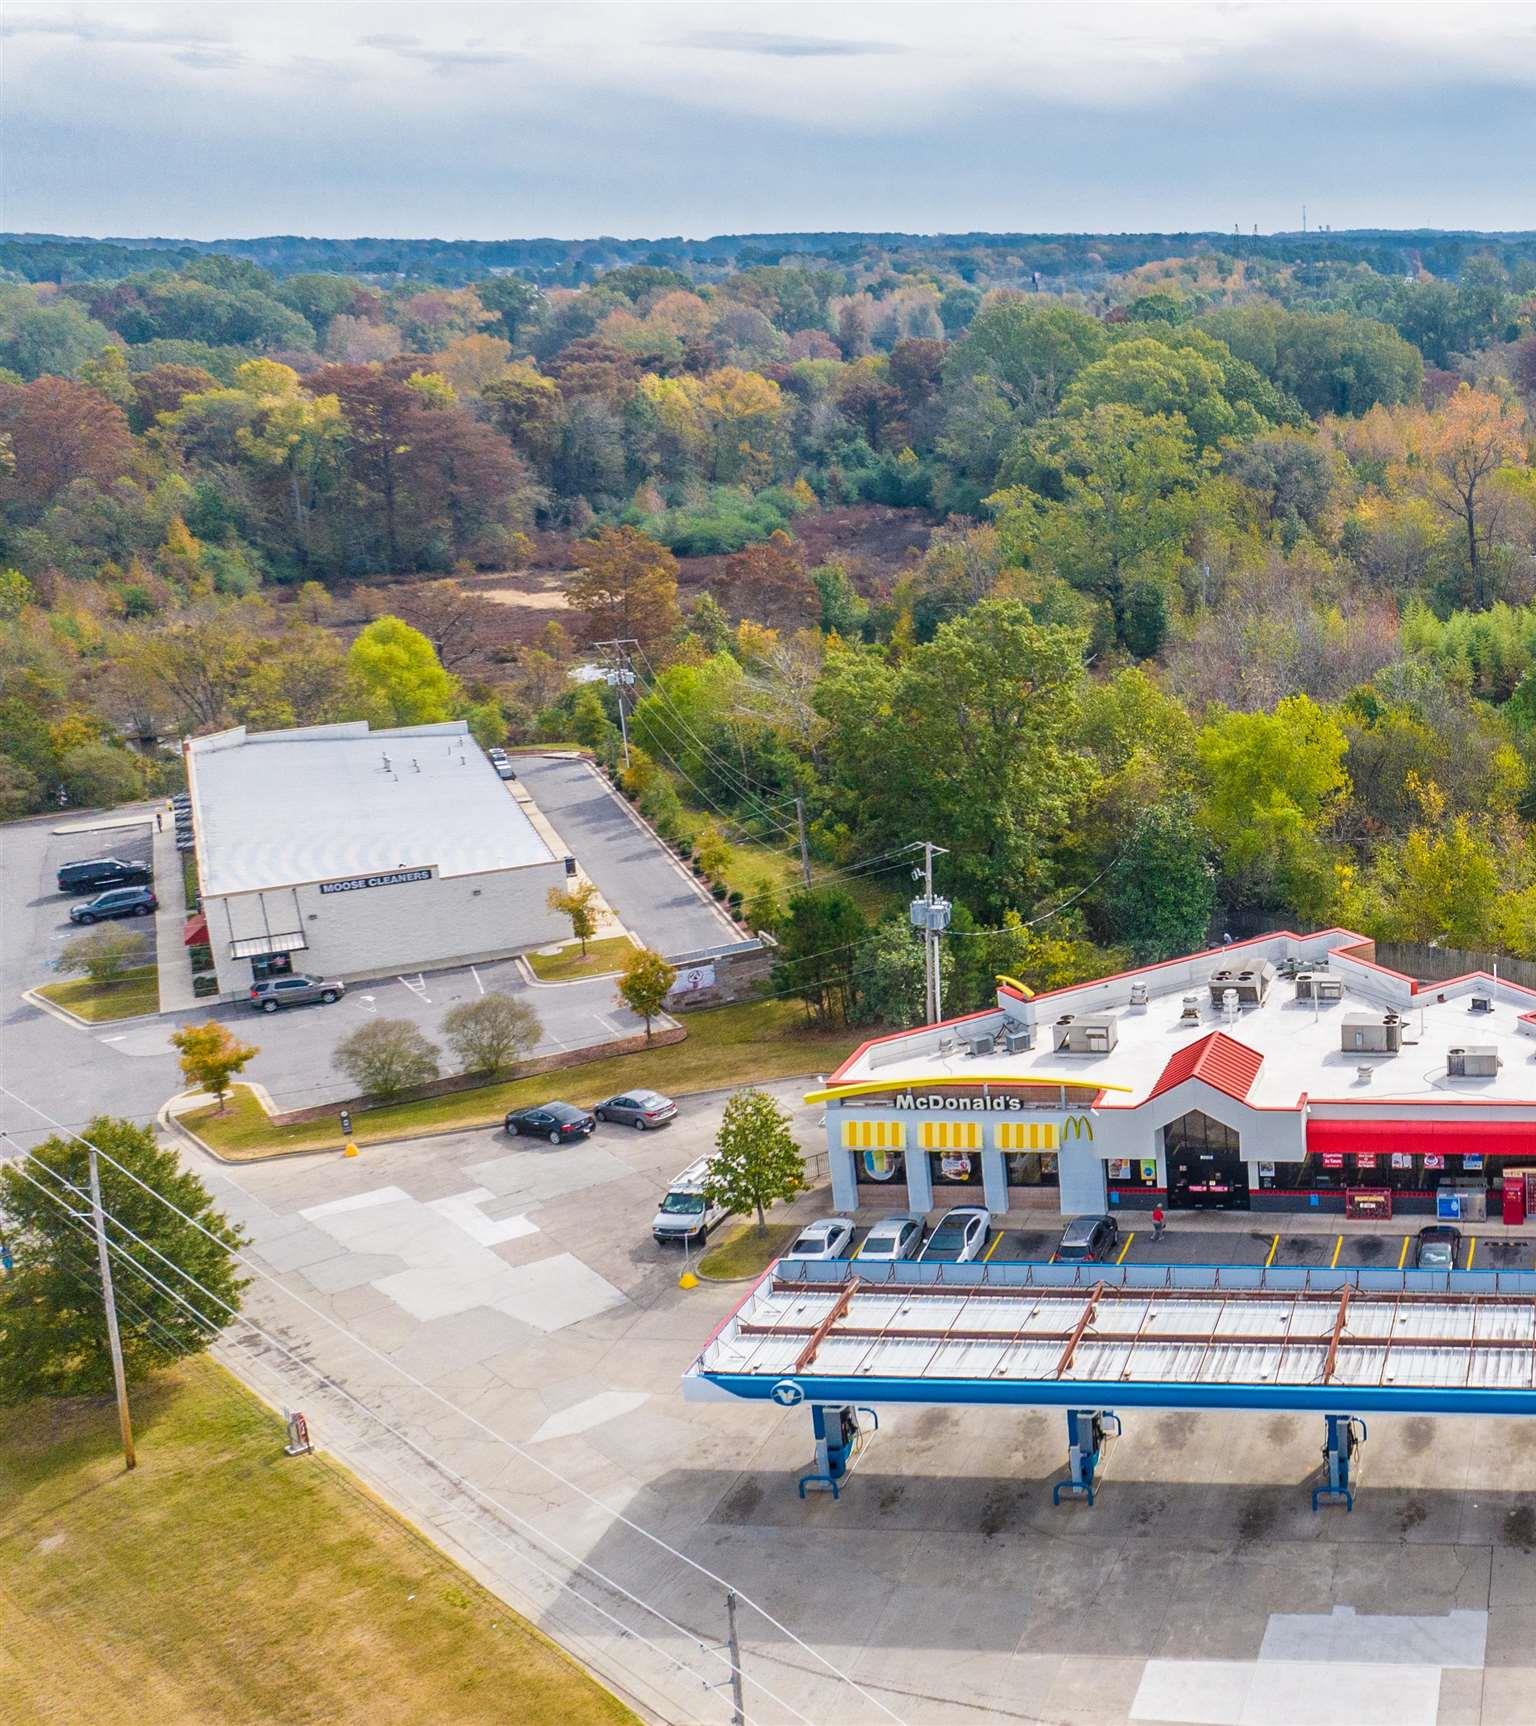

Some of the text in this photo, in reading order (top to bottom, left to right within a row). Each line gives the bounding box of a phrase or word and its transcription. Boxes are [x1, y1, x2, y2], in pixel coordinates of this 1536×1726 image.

[323, 871, 429, 893] MOOSE CLEANERS
[896, 1094, 1021, 1110] McDonald's
